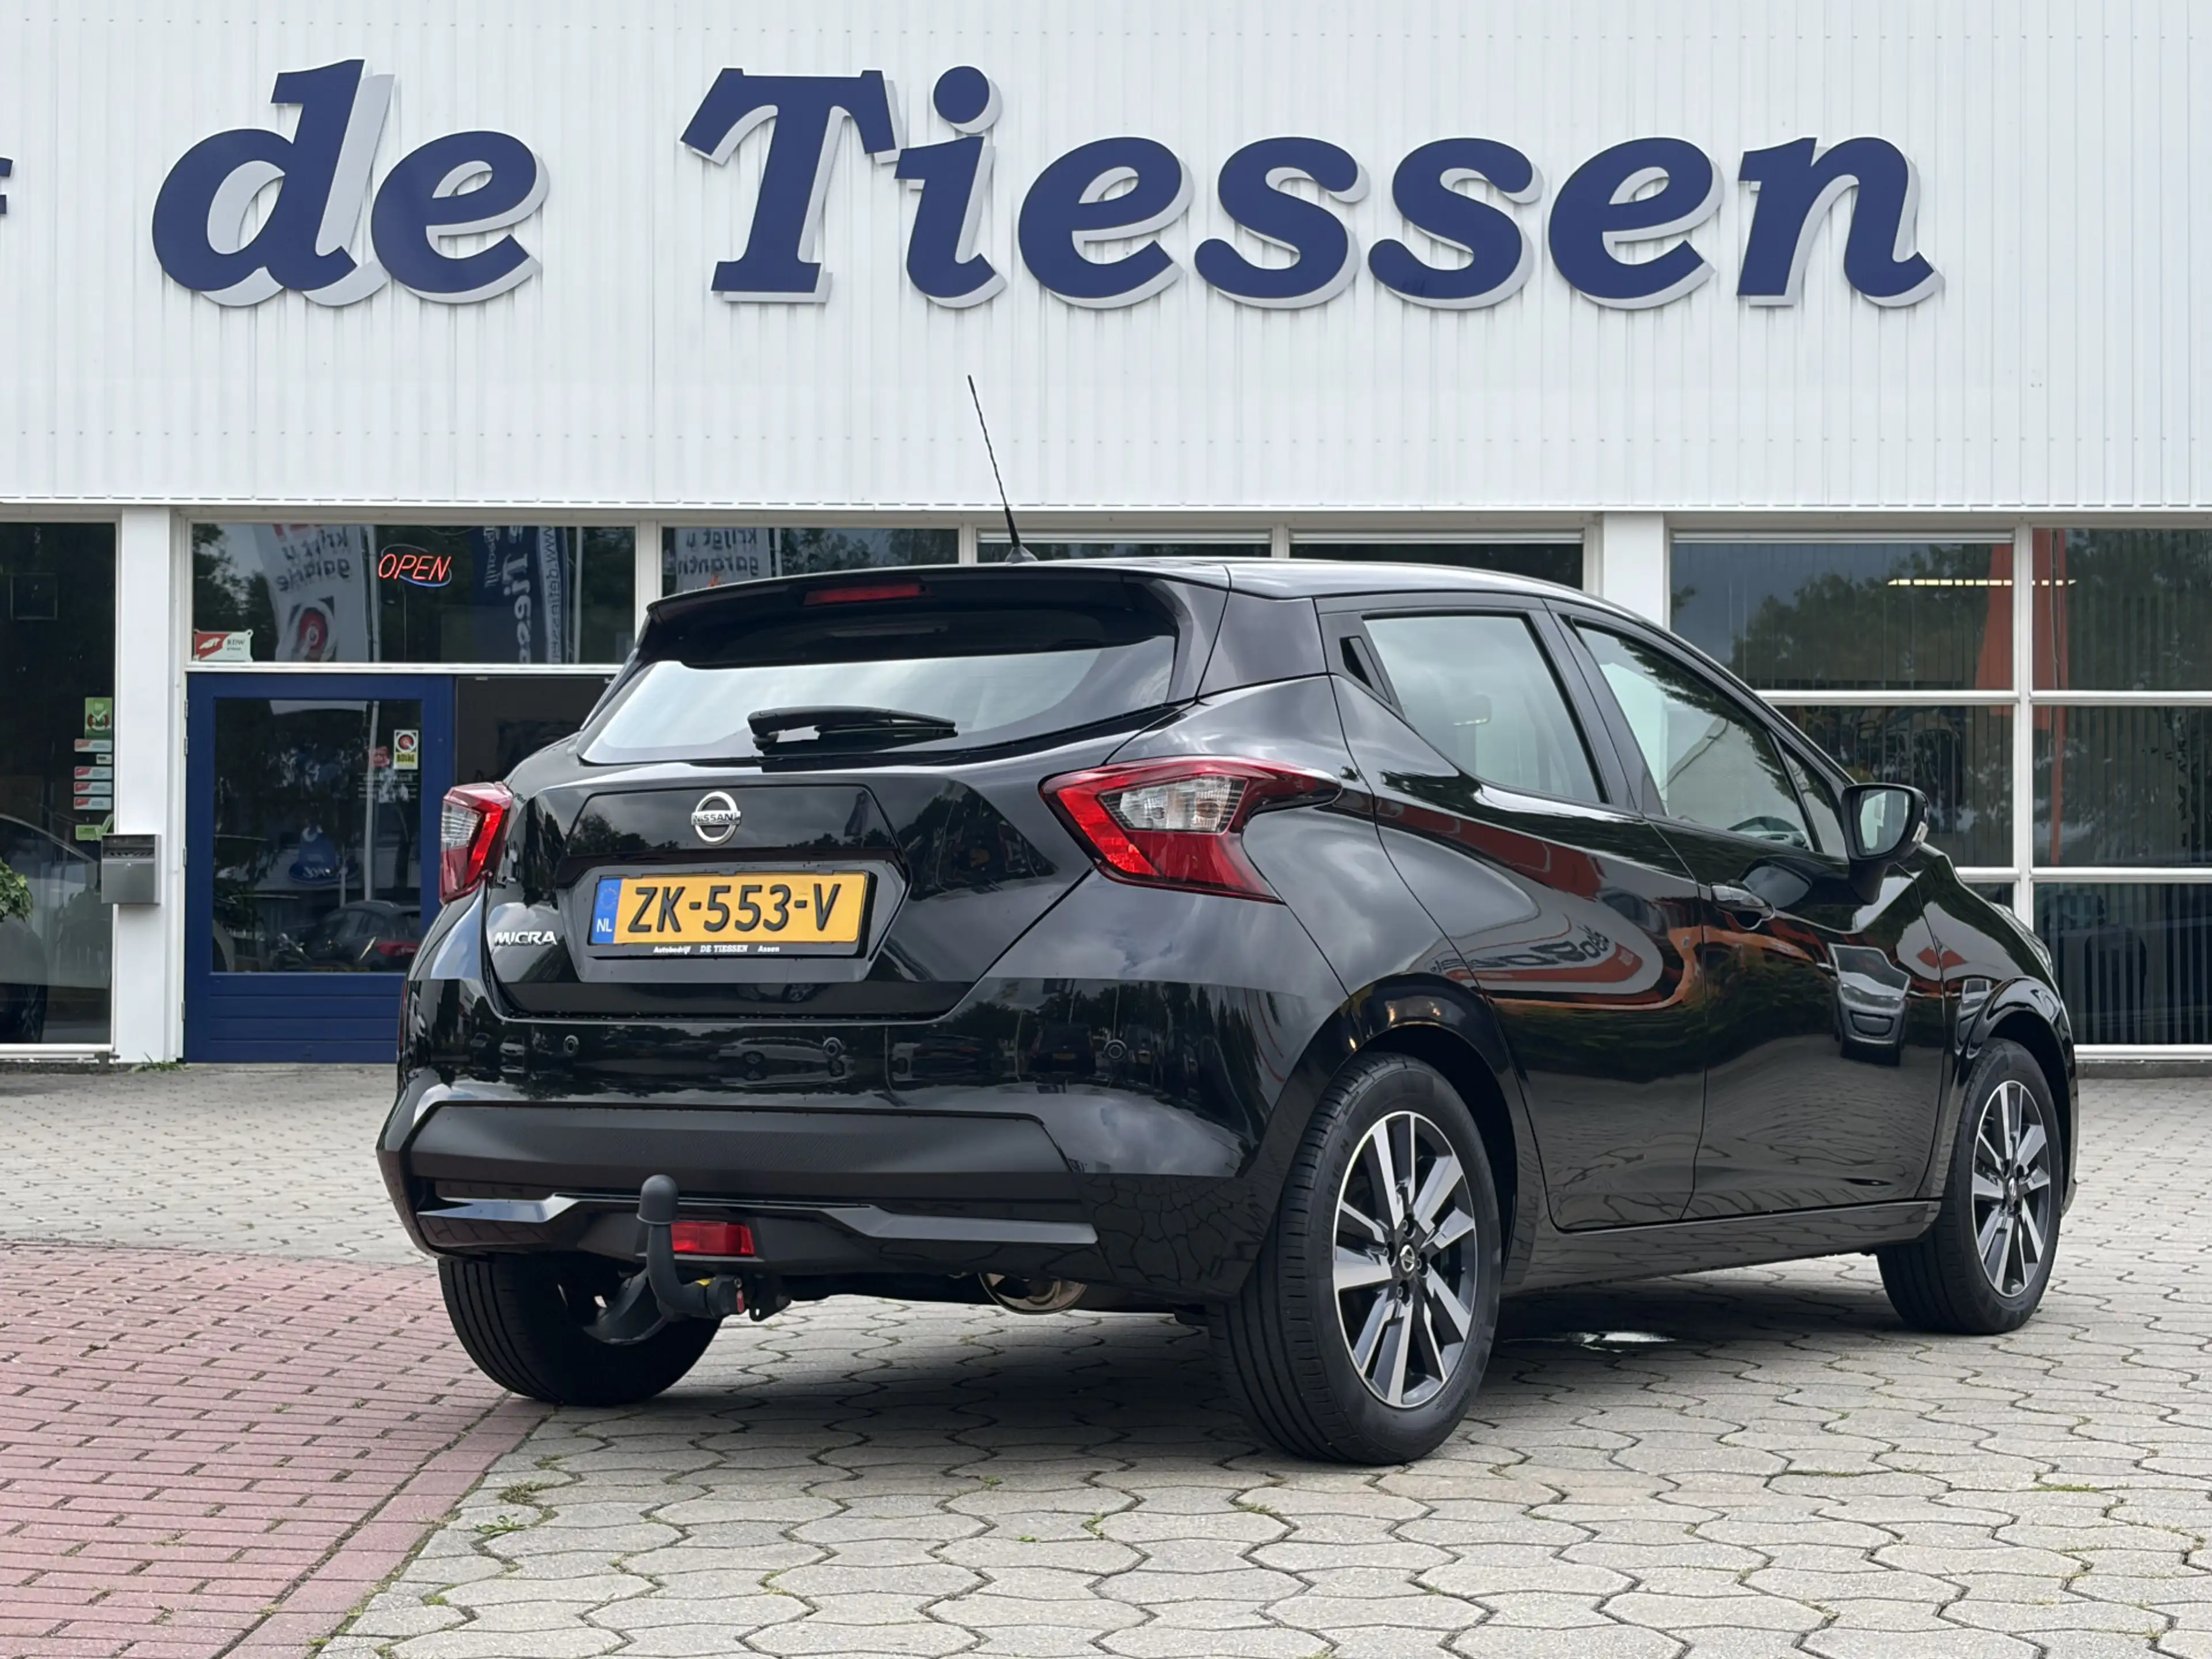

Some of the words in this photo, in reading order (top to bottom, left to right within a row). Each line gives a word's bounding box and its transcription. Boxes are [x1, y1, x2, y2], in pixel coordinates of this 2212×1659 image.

[153, 59, 536, 293] de
[681, 66, 1934, 298] Tiessen
[378, 554, 452, 582] OPEN
[693, 813, 733, 823] NISSAN
[627, 882, 842, 933] ZK-553-V
[596, 918, 613, 933] NL
[494, 930, 558, 946] MICRA
[653, 945, 692, 955] Autobedrijf
[699, 944, 712, 953] DE
[714, 944, 749, 953] TIESSEN
[757, 945, 781, 953] Assen
